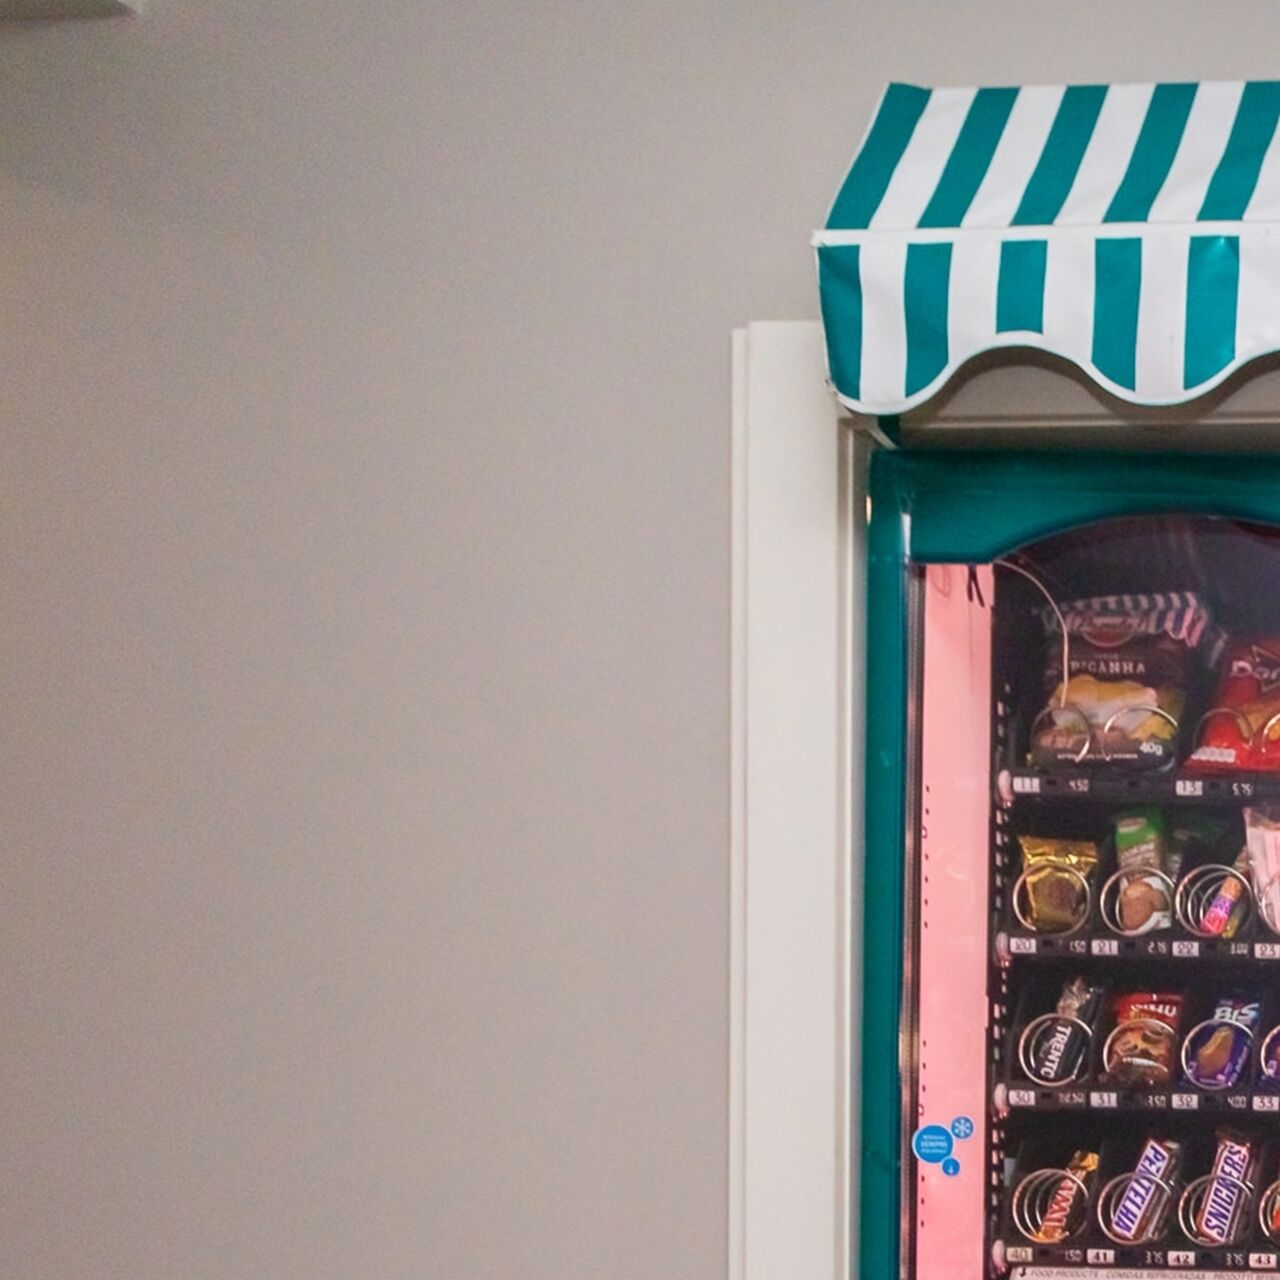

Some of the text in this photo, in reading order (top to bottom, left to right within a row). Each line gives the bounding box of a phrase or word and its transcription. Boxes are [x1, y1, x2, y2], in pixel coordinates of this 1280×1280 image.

[1204, 1144, 1249, 1239] SNICKERS
[1092, 1250, 1109, 1262] 41
[1174, 1252, 1191, 1264] 42
[1254, 1254, 1272, 1266] 43
